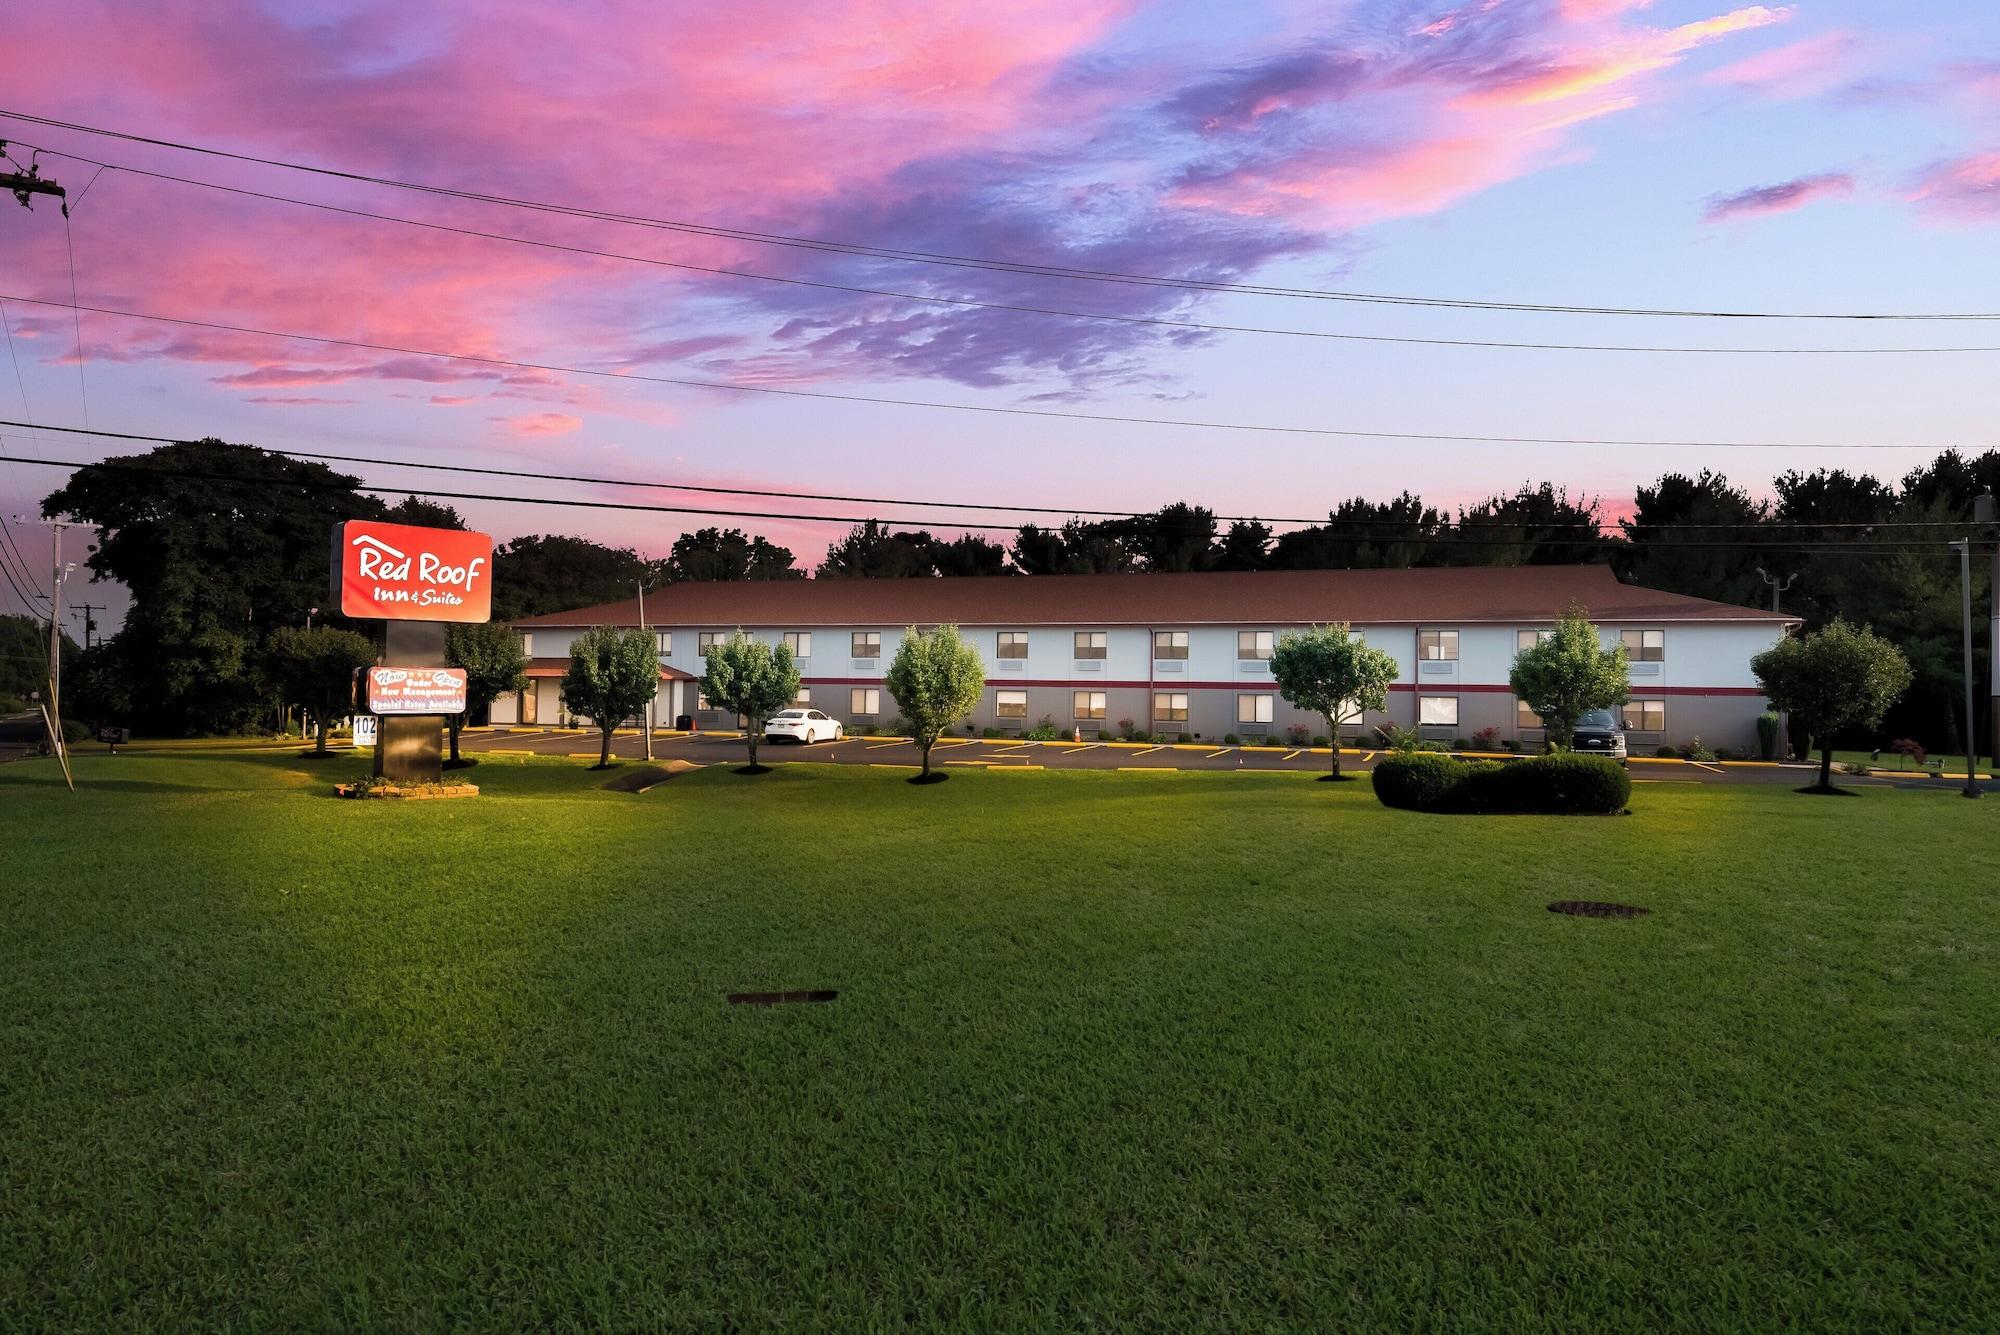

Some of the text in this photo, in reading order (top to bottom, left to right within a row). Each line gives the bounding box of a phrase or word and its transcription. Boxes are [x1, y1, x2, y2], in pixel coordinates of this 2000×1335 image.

[359, 547, 485, 592] Red Roof
[373, 586, 463, 606] Inn & Suites
[377, 671, 461, 686] Now Open
[406, 679, 433, 687] Under
[380, 687, 457, 697] New Management
[372, 700, 402, 710] Special
[428, 700, 464, 709] Available
[355, 717, 376, 734] 102
